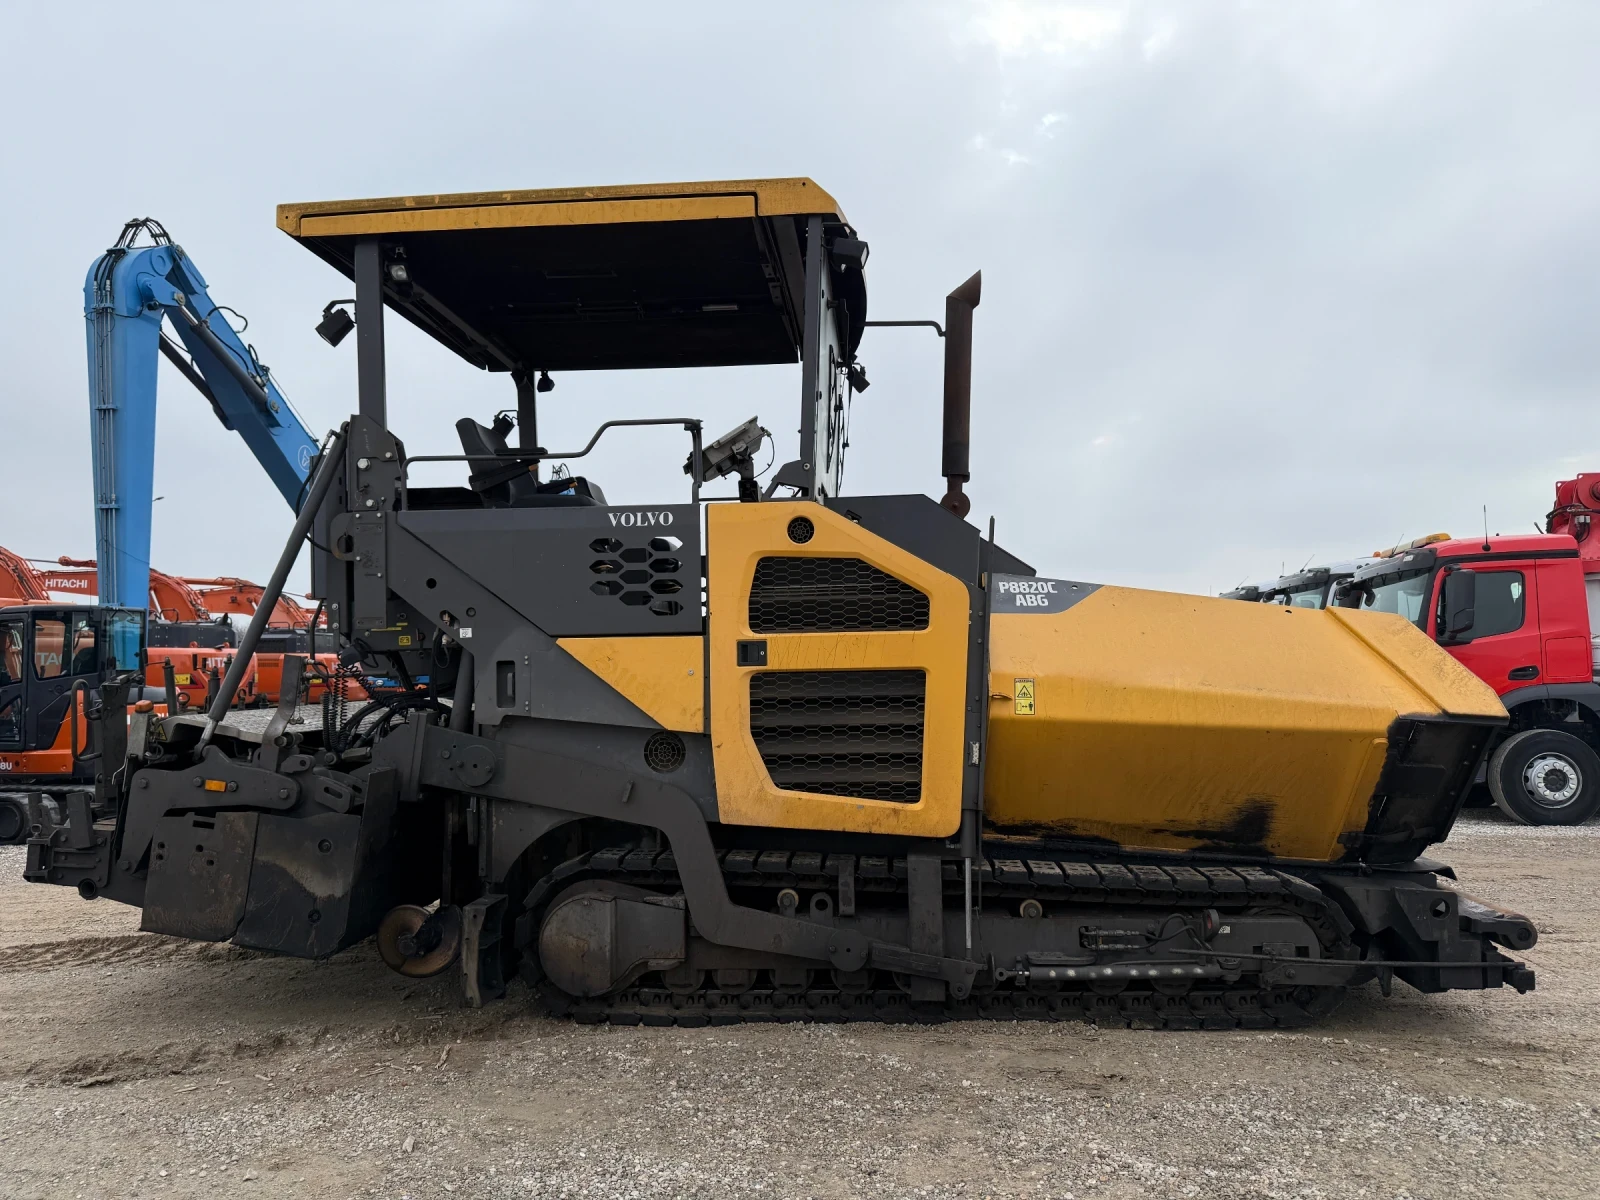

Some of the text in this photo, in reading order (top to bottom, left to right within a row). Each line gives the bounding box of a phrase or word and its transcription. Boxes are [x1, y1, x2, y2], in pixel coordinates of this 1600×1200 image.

[607, 511, 674, 528] VOLVO
[45, 578, 88, 589] HITACHI
[998, 581, 1058, 594] P8820C
[1015, 594, 1049, 607] ABG
